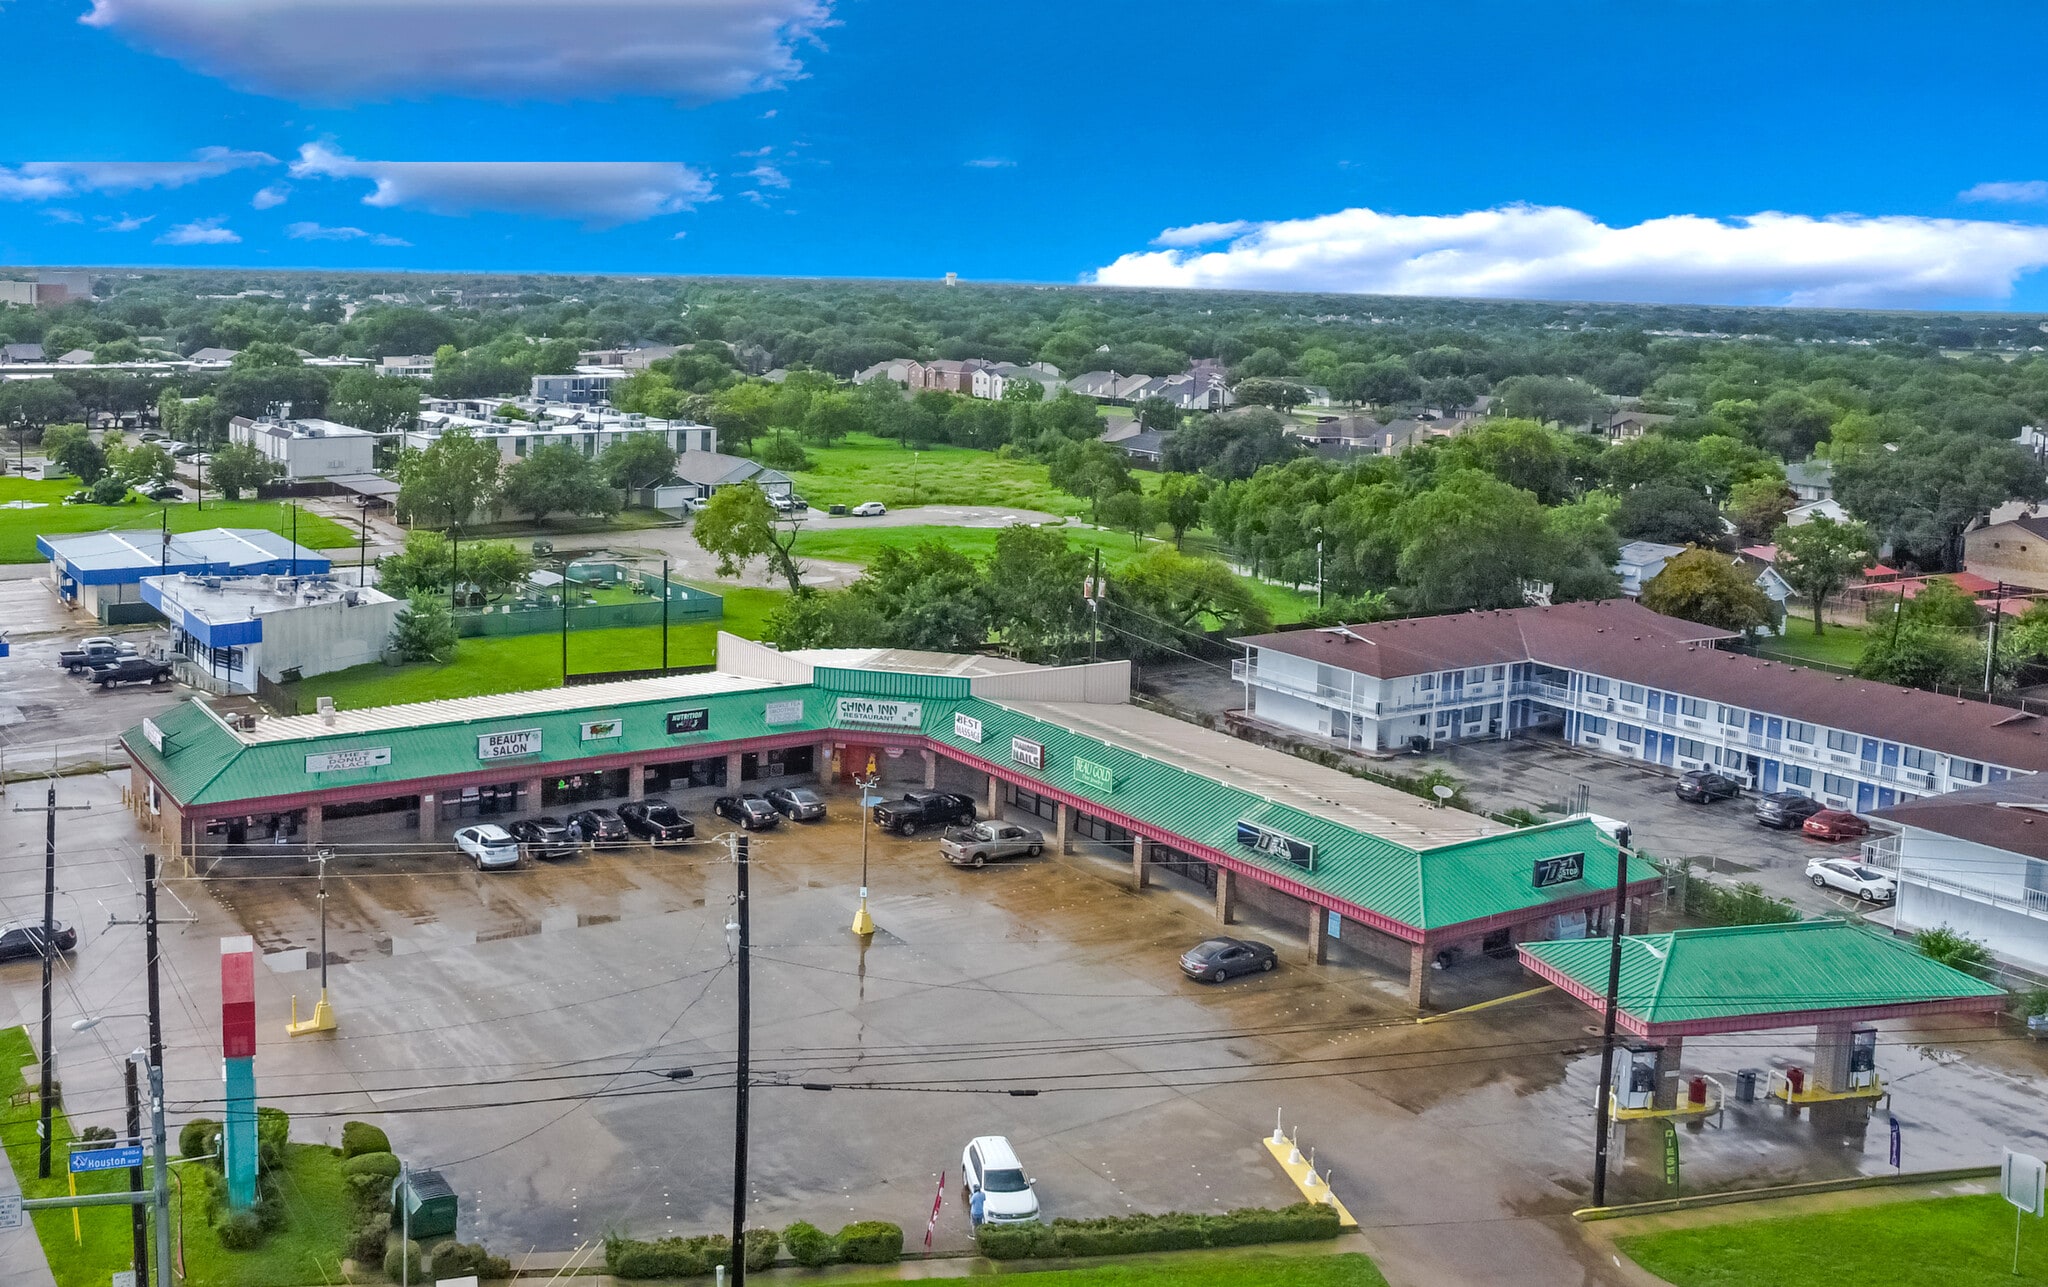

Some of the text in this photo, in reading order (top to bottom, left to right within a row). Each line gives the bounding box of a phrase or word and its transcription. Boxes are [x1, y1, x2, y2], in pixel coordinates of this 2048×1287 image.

[841, 701, 873, 714] CHINA
[878, 704, 898, 716] INN
[672, 711, 703, 721] NUTRITION
[843, 712, 894, 721] RESTAURANT
[957, 715, 978, 729] BEST
[490, 732, 530, 746] BEAUTY
[493, 744, 527, 756] SALON
[329, 756, 368, 764] DONUT
[1013, 748, 1039, 767] NAILS
[327, 761, 370, 770] PALACE
[1562, 868, 1578, 876] STOP
[88, 1157, 126, 1168] Houston
[1665, 1129, 1676, 1185] DIESEL
